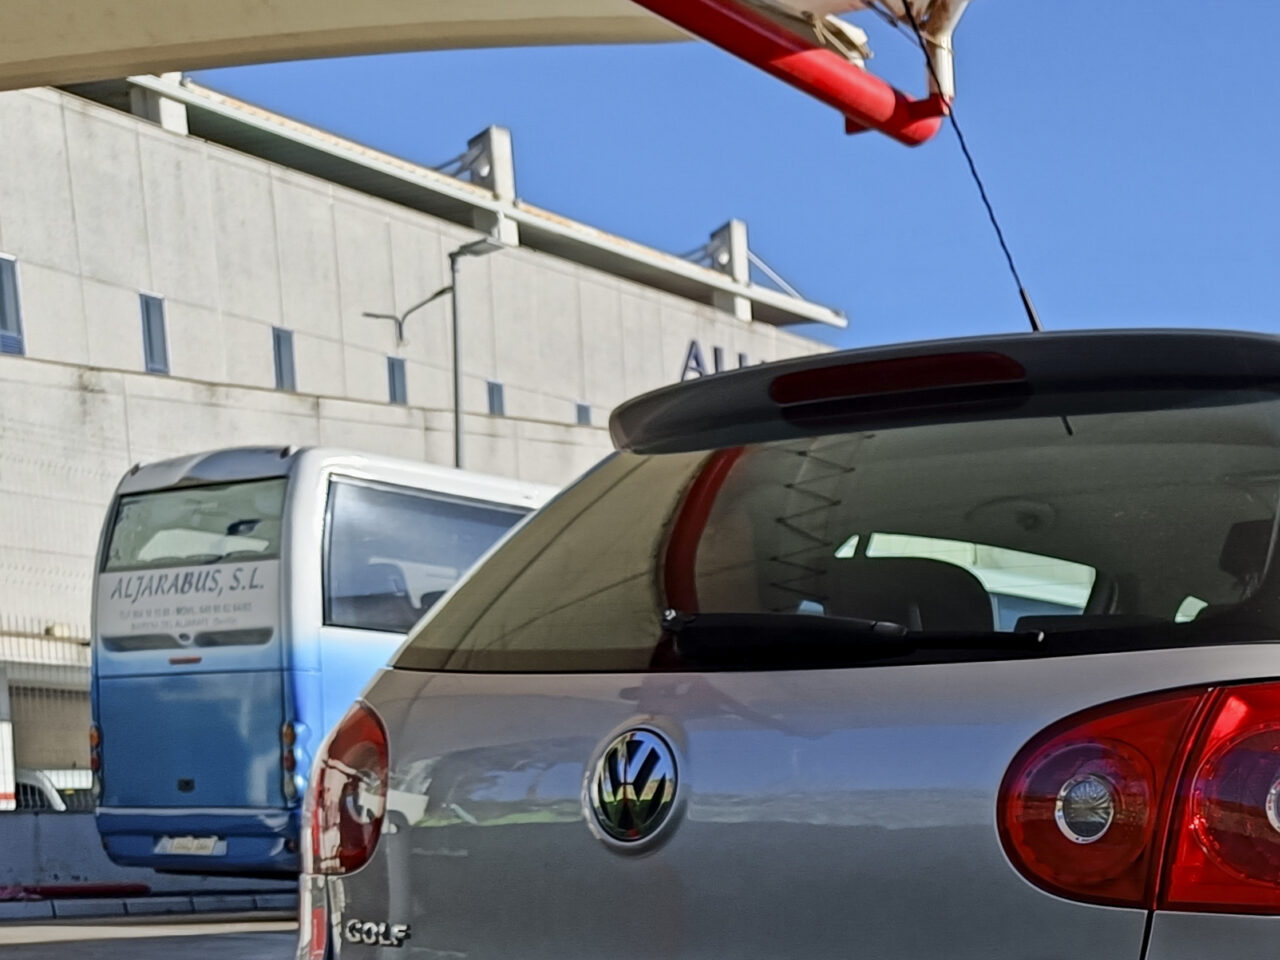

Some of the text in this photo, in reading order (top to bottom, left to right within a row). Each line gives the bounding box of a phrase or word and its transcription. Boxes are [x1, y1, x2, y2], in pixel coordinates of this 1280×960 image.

[111, 567, 264, 603] ALJARABUS, S.L.
[345, 919, 409, 945] GOLF
